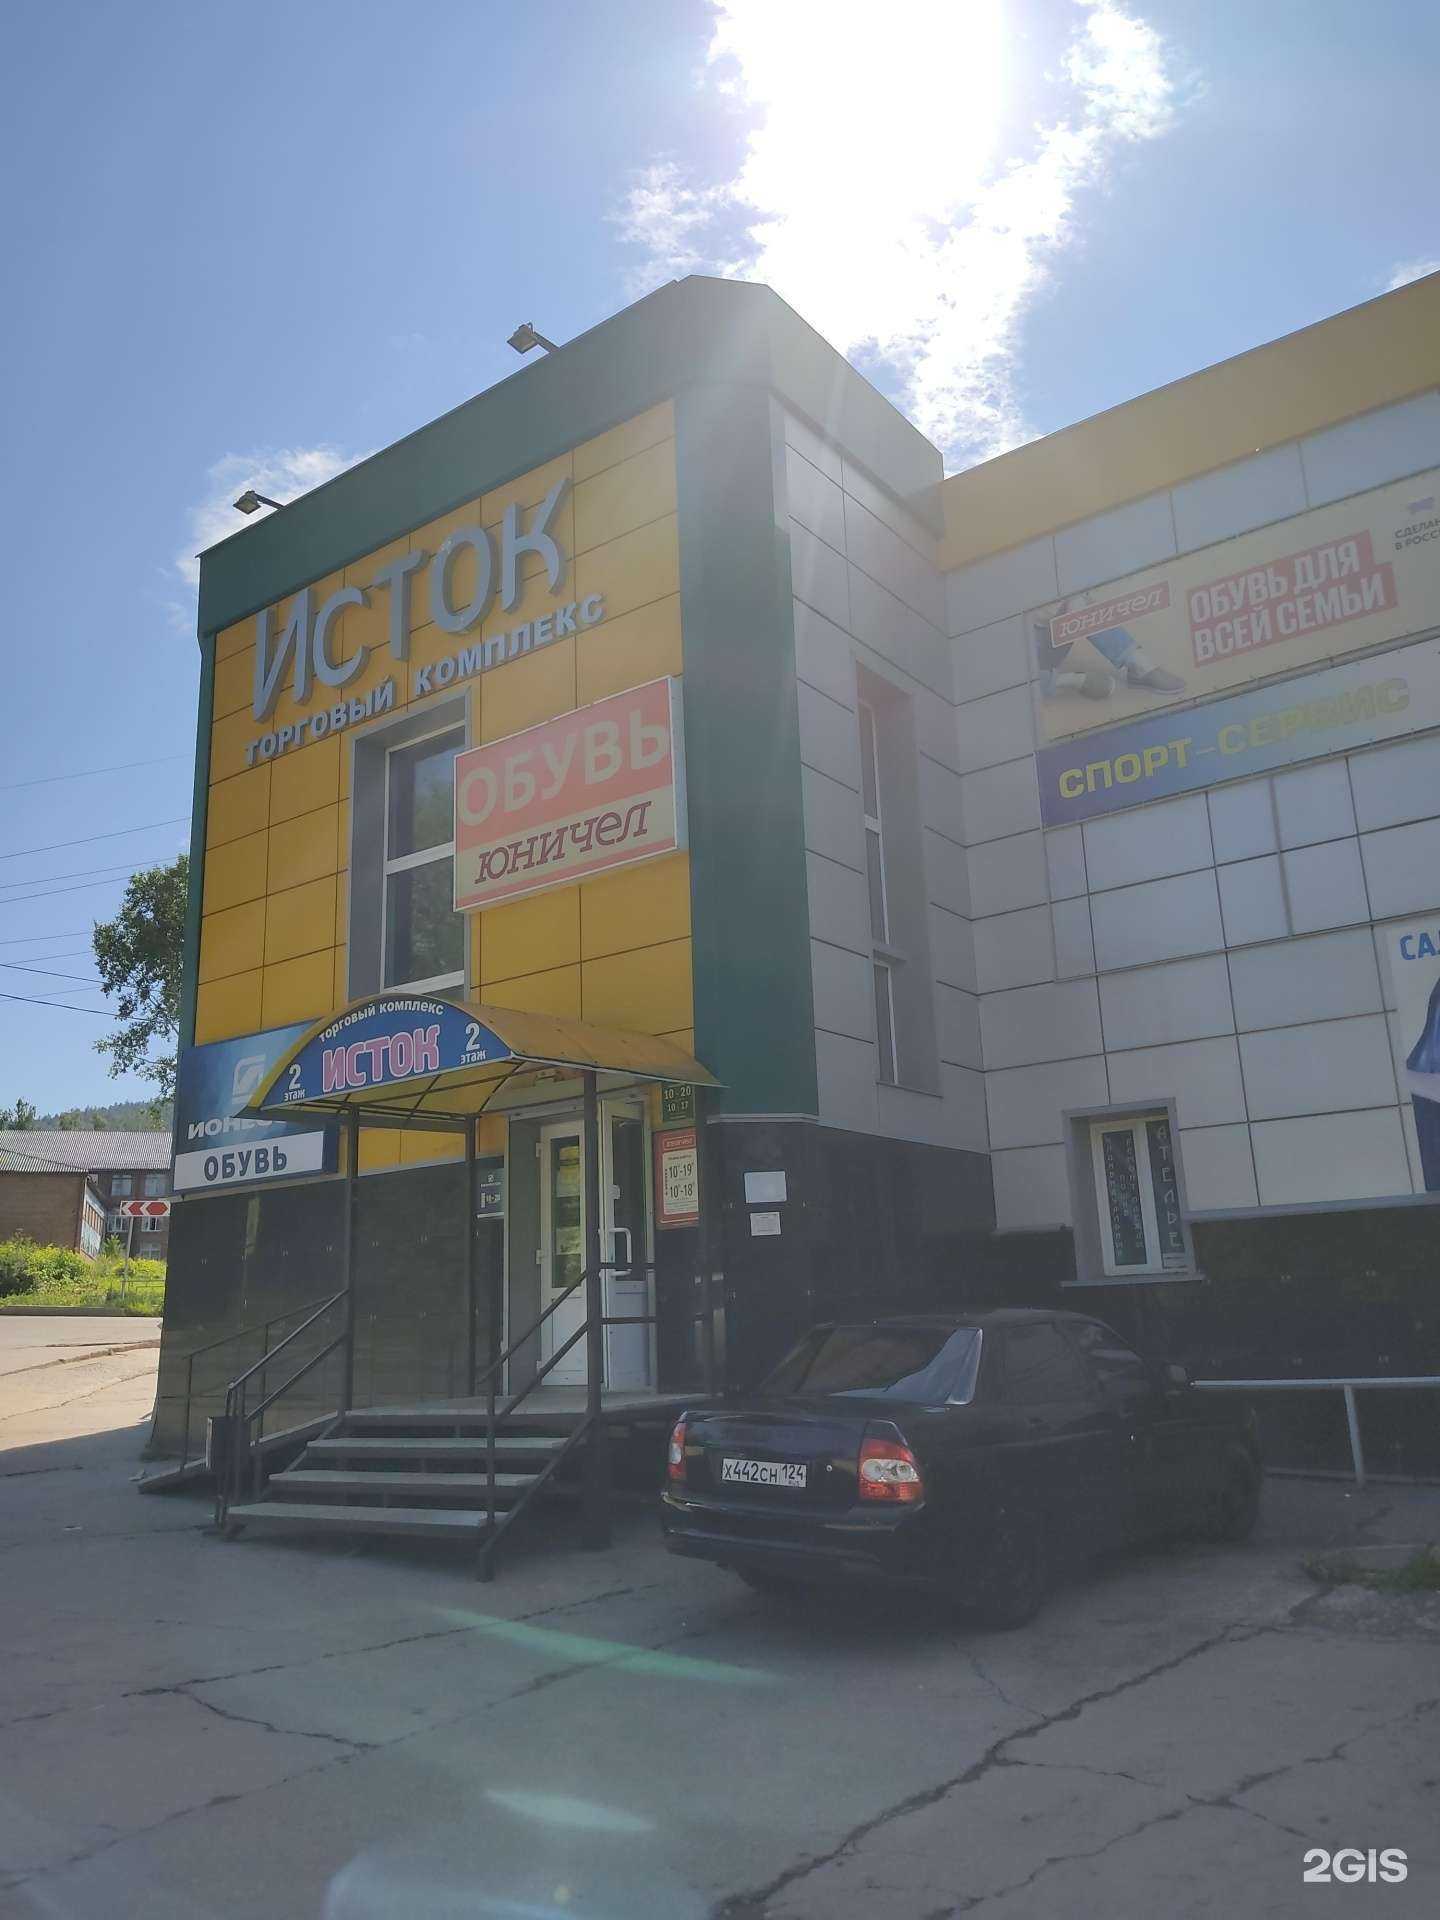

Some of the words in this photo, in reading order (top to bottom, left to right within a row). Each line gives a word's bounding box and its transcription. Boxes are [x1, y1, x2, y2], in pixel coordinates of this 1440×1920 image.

[1406, 530, 1440, 546] РОСС
[251, 476, 576, 723] ИСТОК
[1191, 568, 1289, 624] ОБУВЬ
[1293, 541, 1361, 595] ДЛЯ
[1193, 605, 1273, 662] ВСЕЙ
[1276, 573, 1385, 634] СЕМЬИ
[245, 674, 397, 767] ТОРГОВЫЙ
[414, 593, 606, 698] КОМПЛЕКС
[458, 709, 668, 827] ОБУВЬ
[1400, 930, 1440, 960] СА
[322, 1024, 440, 1093] ИСТОК
[460, 1050, 486, 1065] этаж
[465, 1022, 481, 1051] 2
[288, 1063, 302, 1090] 2
[203, 1146, 287, 1181] ОБУВЬ
[1157, 1126, 1183, 1247] АТЕЛЬЕ
[725, 1461, 777, 1483] Х442СН
[782, 1465, 803, 1480] 124
